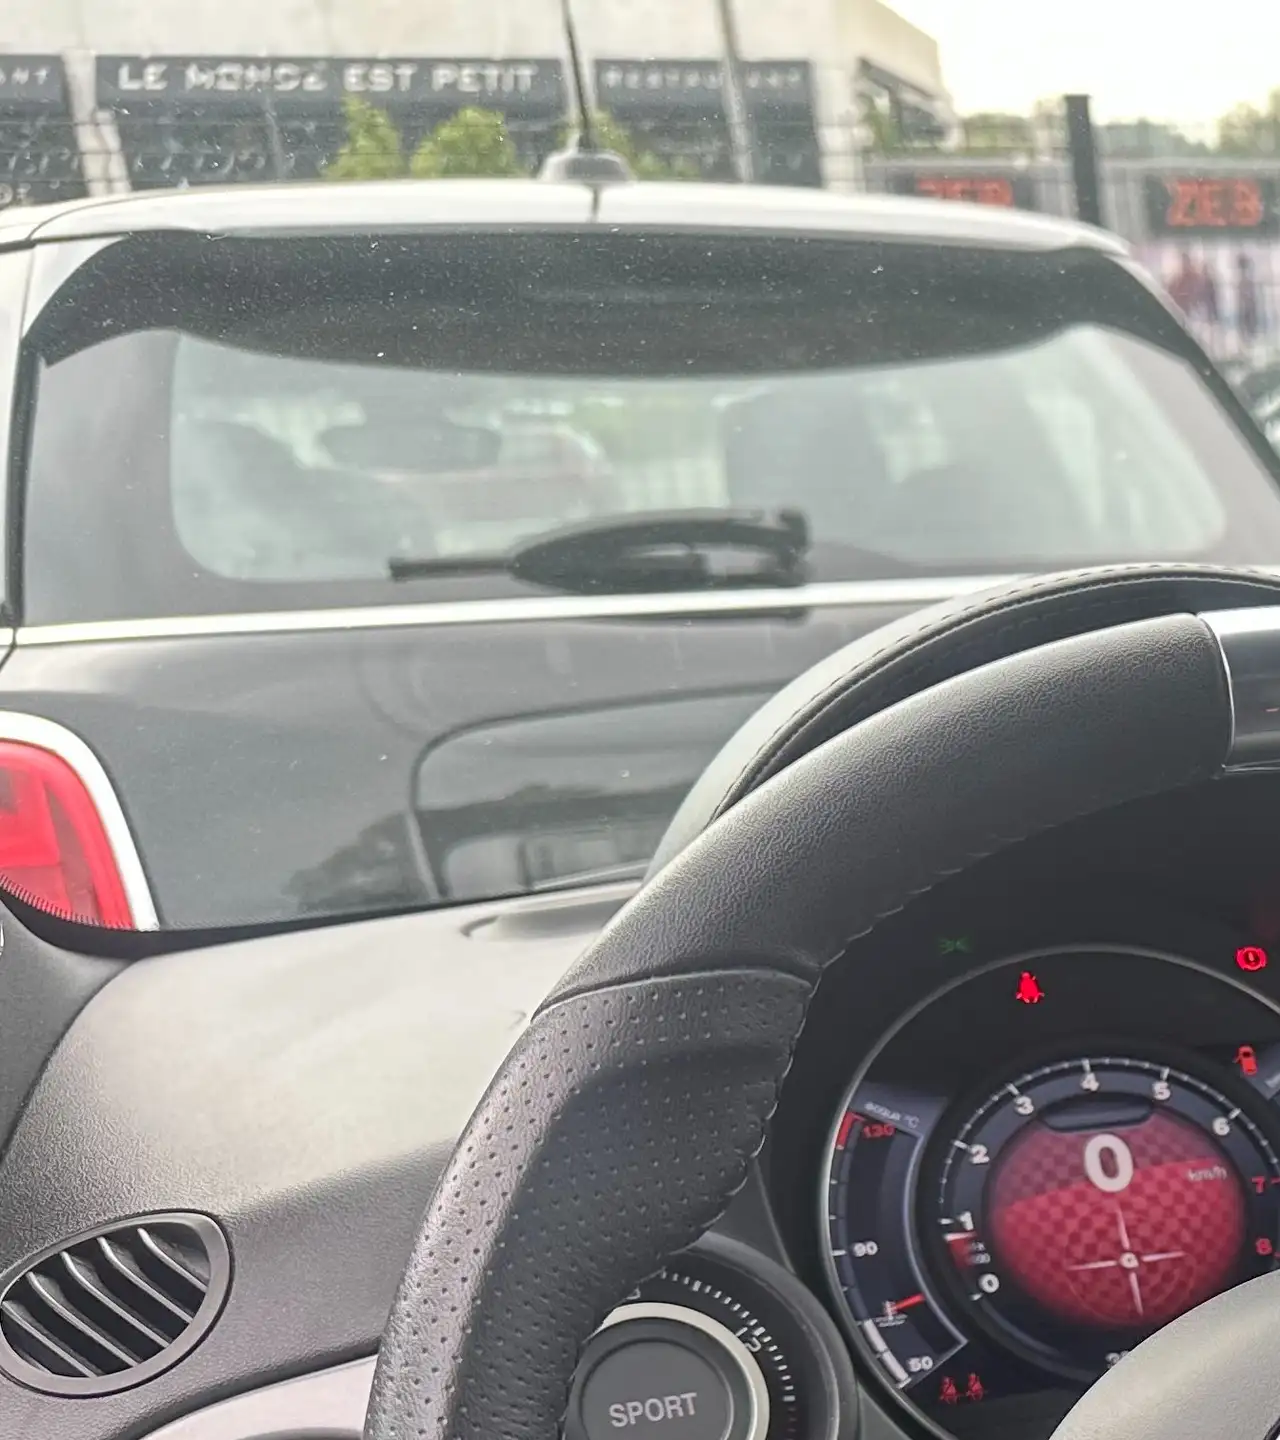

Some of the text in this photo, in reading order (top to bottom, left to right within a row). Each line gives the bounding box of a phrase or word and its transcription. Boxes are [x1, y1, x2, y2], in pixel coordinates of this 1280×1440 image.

[118, 63, 168, 91] LE
[342, 63, 416, 91] EST
[430, 63, 538, 91] PETIT
[1082, 1073, 1098, 1092] 4
[1153, 1080, 1171, 1101] 5
[1015, 1095, 1034, 1114] 3
[1212, 1116, 1231, 1136] 6
[970, 1144, 990, 1164] 2
[1084, 1133, 1134, 1192] 0
[1252, 1176, 1266, 1193] 7
[979, 1273, 1000, 1294] 0
[608, 1392, 697, 1428] SPORT
